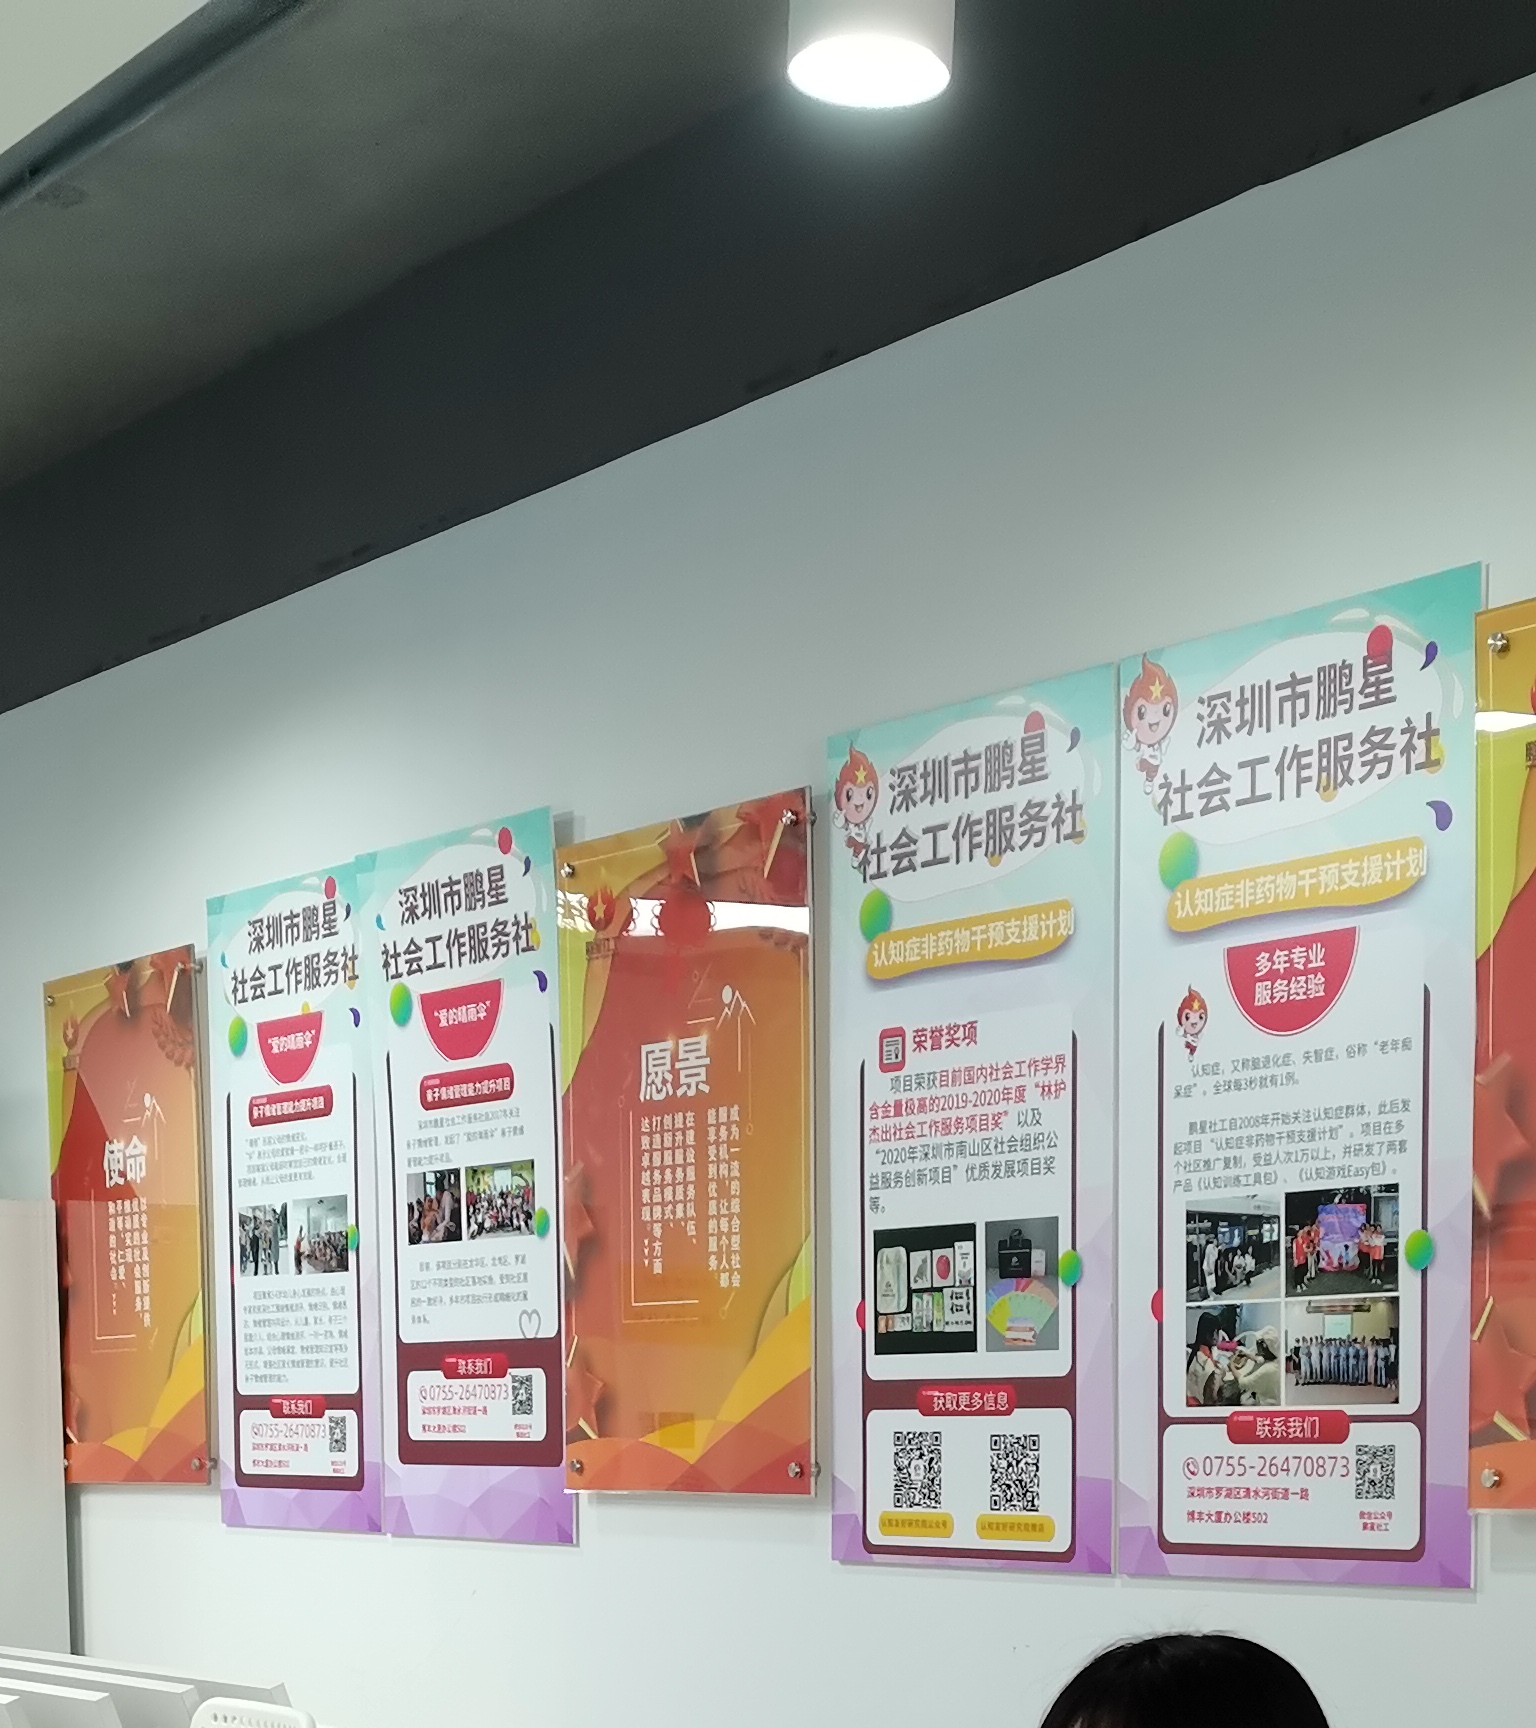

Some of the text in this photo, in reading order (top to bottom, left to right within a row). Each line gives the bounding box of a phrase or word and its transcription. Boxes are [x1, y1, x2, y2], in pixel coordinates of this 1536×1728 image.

[1197, 655, 1396, 748] 深圳市鹏星
[889, 732, 1049, 815] 深圳市鹏星
[1158, 712, 1441, 826] 社会工作服务社
[861, 789, 1084, 883] 社会工作服务社
[399, 864, 508, 926] 深圳市鹏星
[1174, 844, 1427, 919] 认知症非药物干预支援计划
[248, 900, 339, 954] 深圳市鹏星
[382, 911, 537, 981] 社会工作服务社
[872, 907, 1074, 967] 认知症非药物干预支援计划
[231, 944, 359, 1006] 社会工作服务社
[1254, 973, 1325, 1006] 服务经验
[1255, 943, 1325, 977] 多年专业
[912, 1020, 978, 1053] 荣誉奖项
[639, 1035, 711, 1102] 愿景
[102, 1134, 148, 1189] 使命
[933, 1391, 1009, 1411] 获取更多信息
[1256, 1416, 1319, 1439] 联系我们
[1203, 1456, 1350, 1478] 0755-26470873
